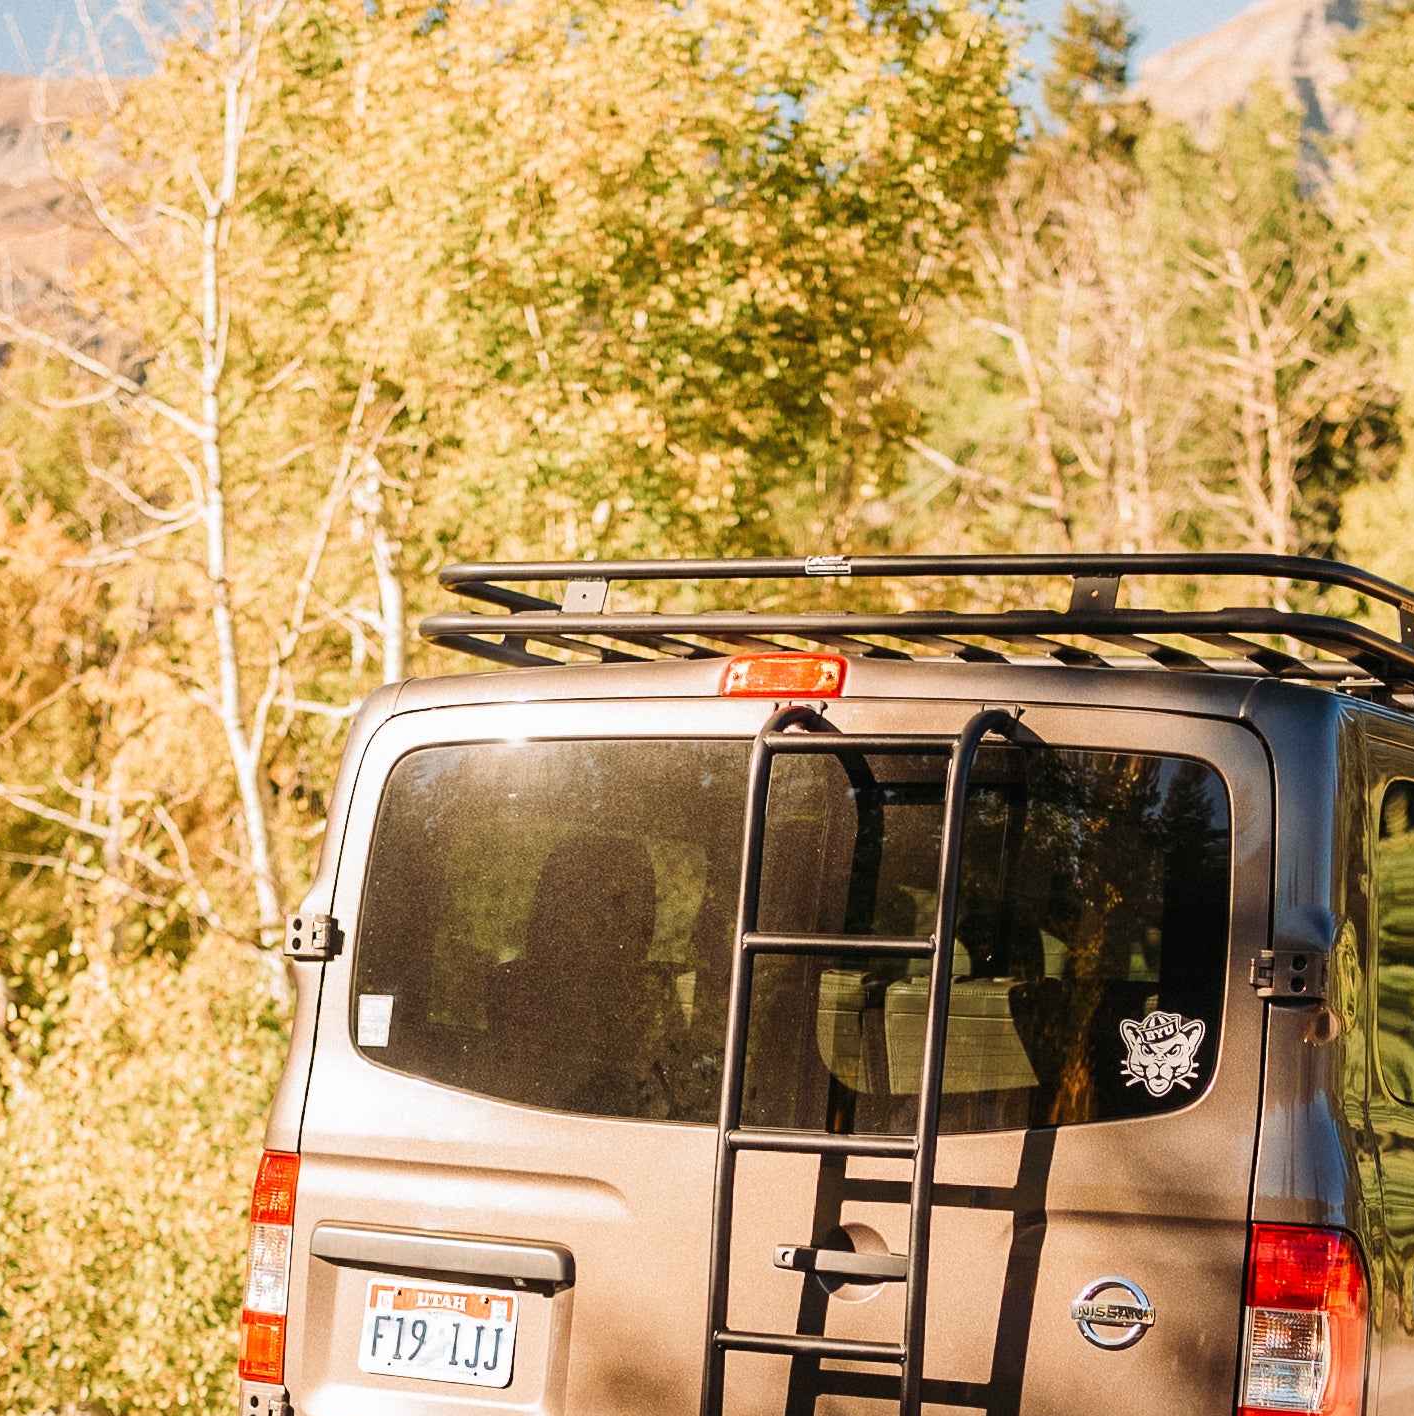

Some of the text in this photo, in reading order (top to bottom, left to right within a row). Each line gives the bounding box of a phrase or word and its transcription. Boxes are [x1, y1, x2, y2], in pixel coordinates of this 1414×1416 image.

[1145, 1023, 1175, 1041] BYU
[416, 1291, 468, 1312] UTAH
[1078, 1305, 1144, 1321] NISSAN
[371, 1315, 504, 1371] F19 1JJ
